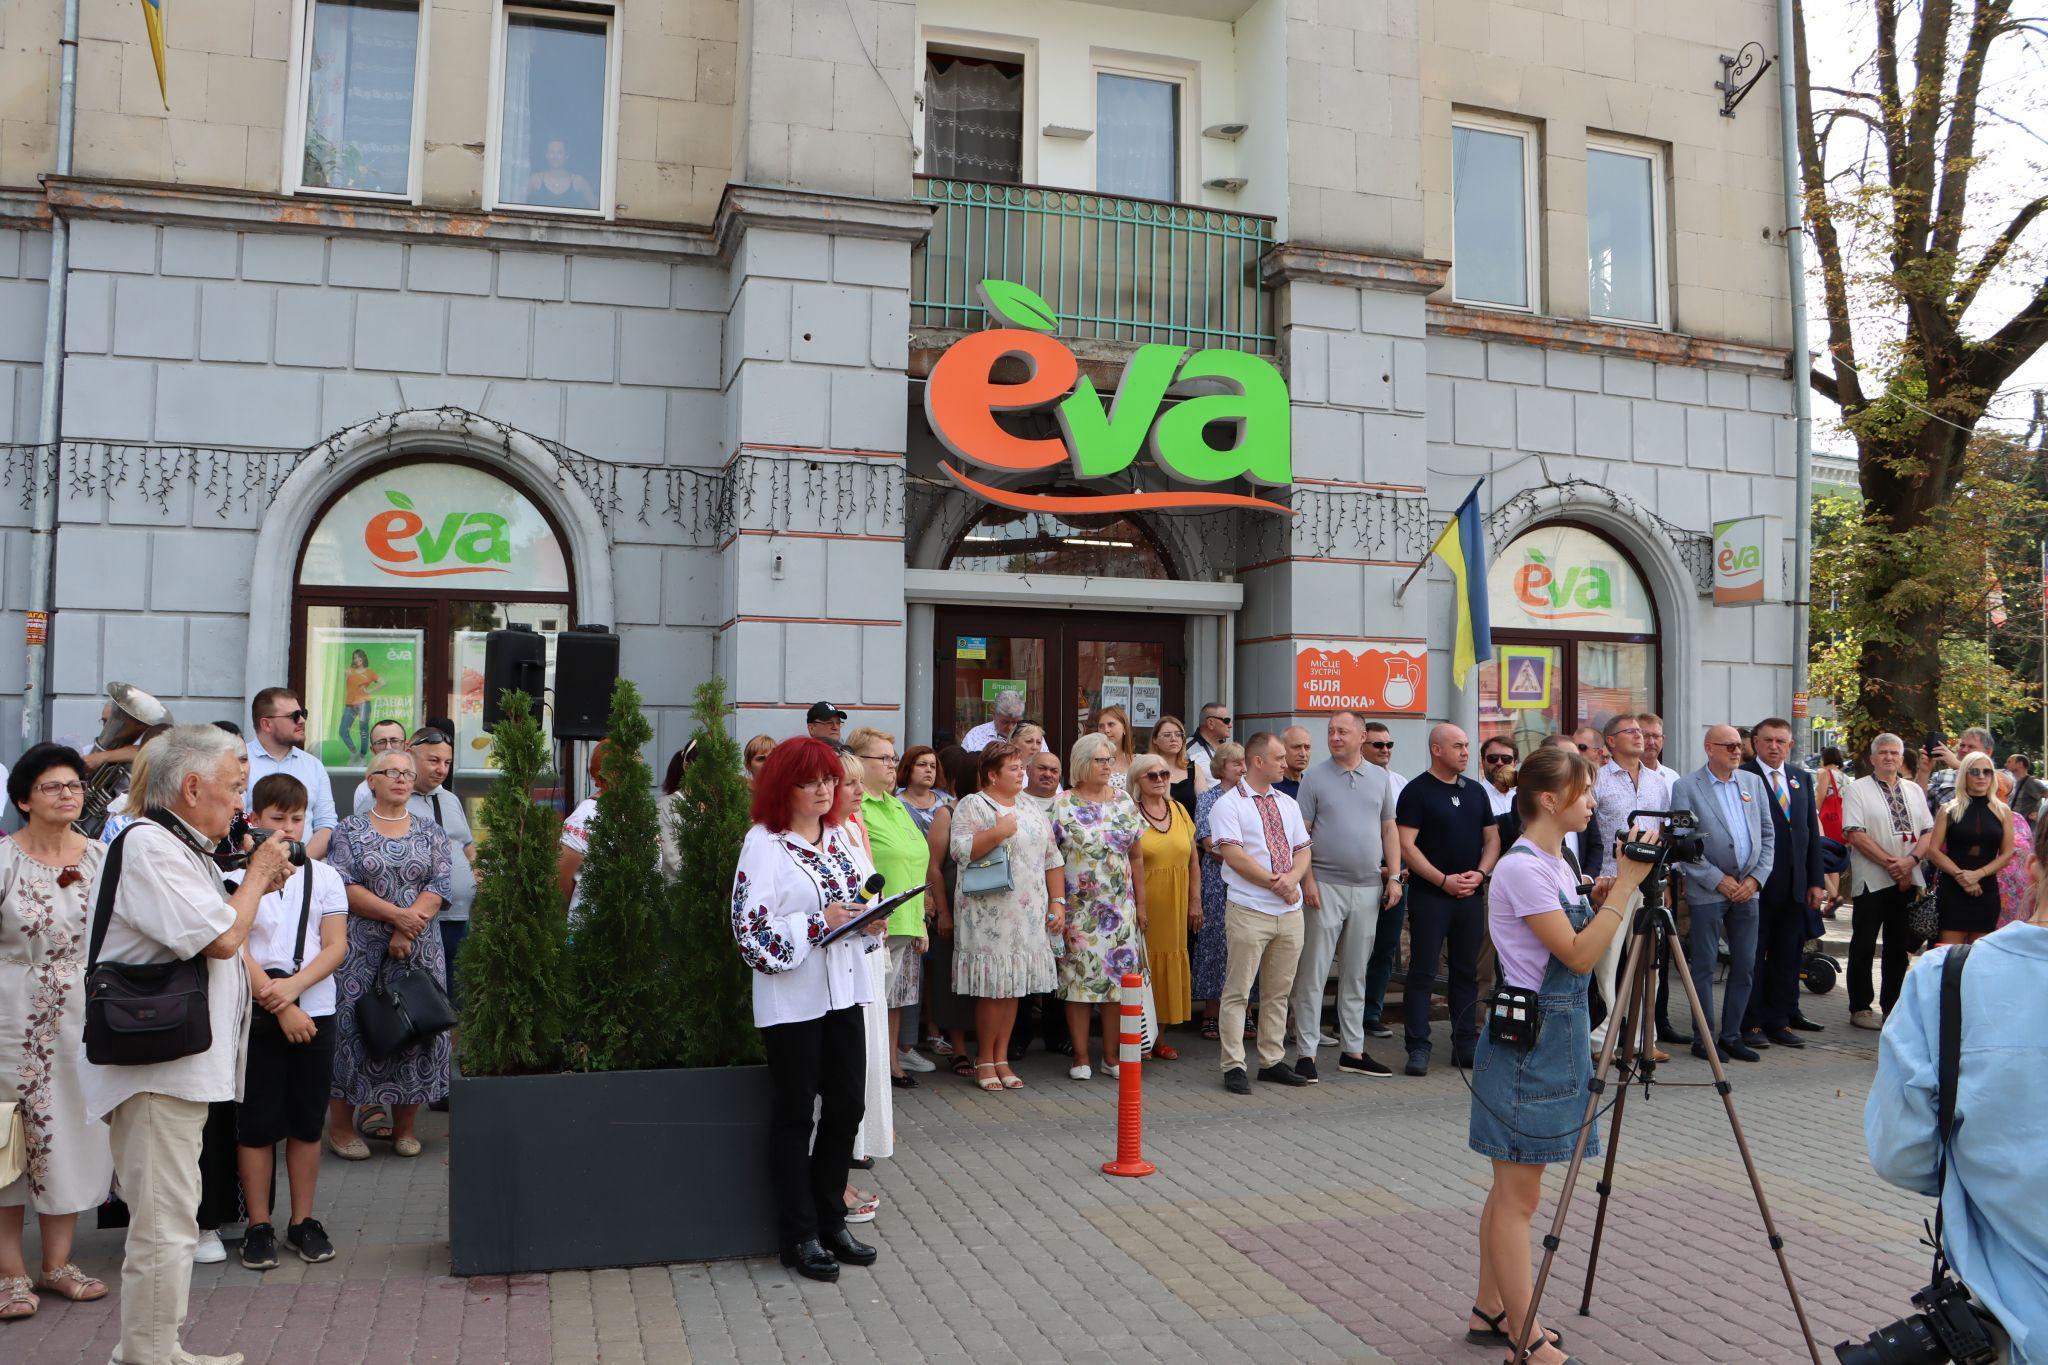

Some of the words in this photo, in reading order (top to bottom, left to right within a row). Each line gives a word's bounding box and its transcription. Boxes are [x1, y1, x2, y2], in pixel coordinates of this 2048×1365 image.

[1310, 661, 1341, 669] МІСЦЕ
[1310, 668, 1341, 676] ЗУСТРІЧІ
[1303, 679, 1341, 692] «БІЛЯ
[1309, 694, 1375, 708] МОЛОКА»
[1636, 847, 1656, 855] Canon
